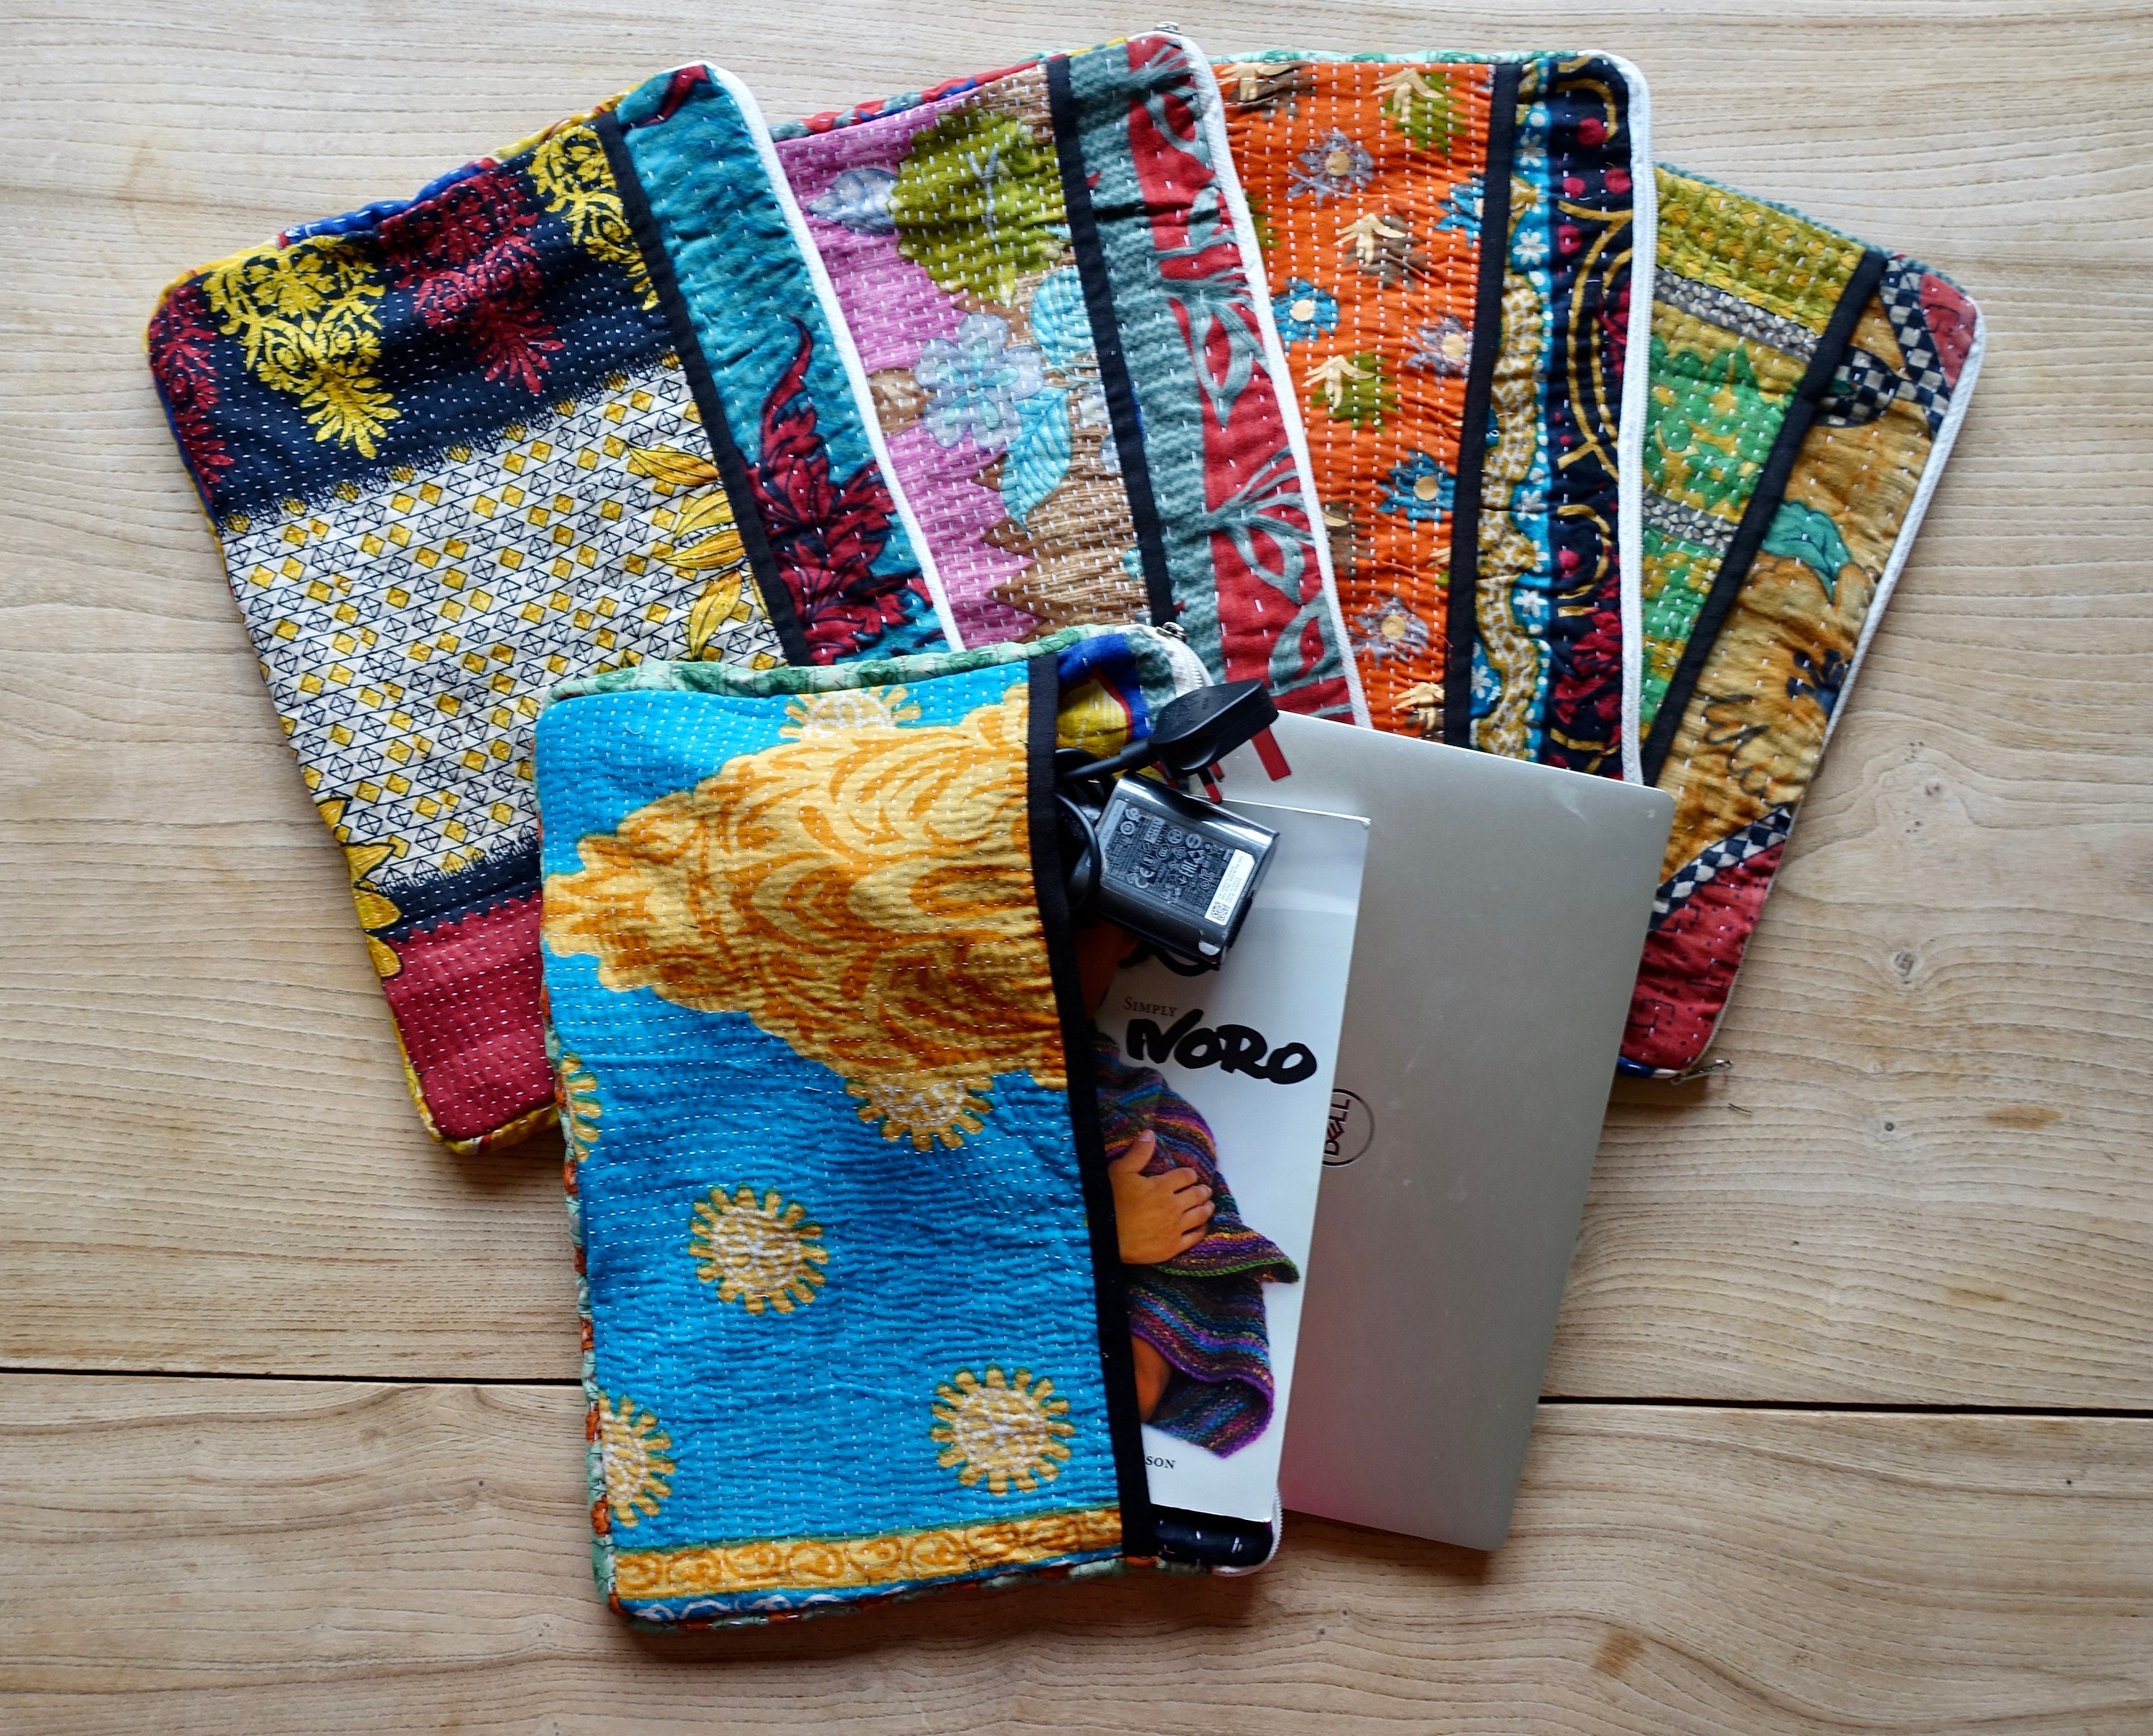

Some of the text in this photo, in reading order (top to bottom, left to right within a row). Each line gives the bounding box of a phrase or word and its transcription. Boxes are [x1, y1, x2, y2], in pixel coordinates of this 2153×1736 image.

[1123, 996, 1178, 1017] SIMPLY
[1126, 1008, 1318, 1085] NORO
[1323, 1099, 1351, 1156] DELL
